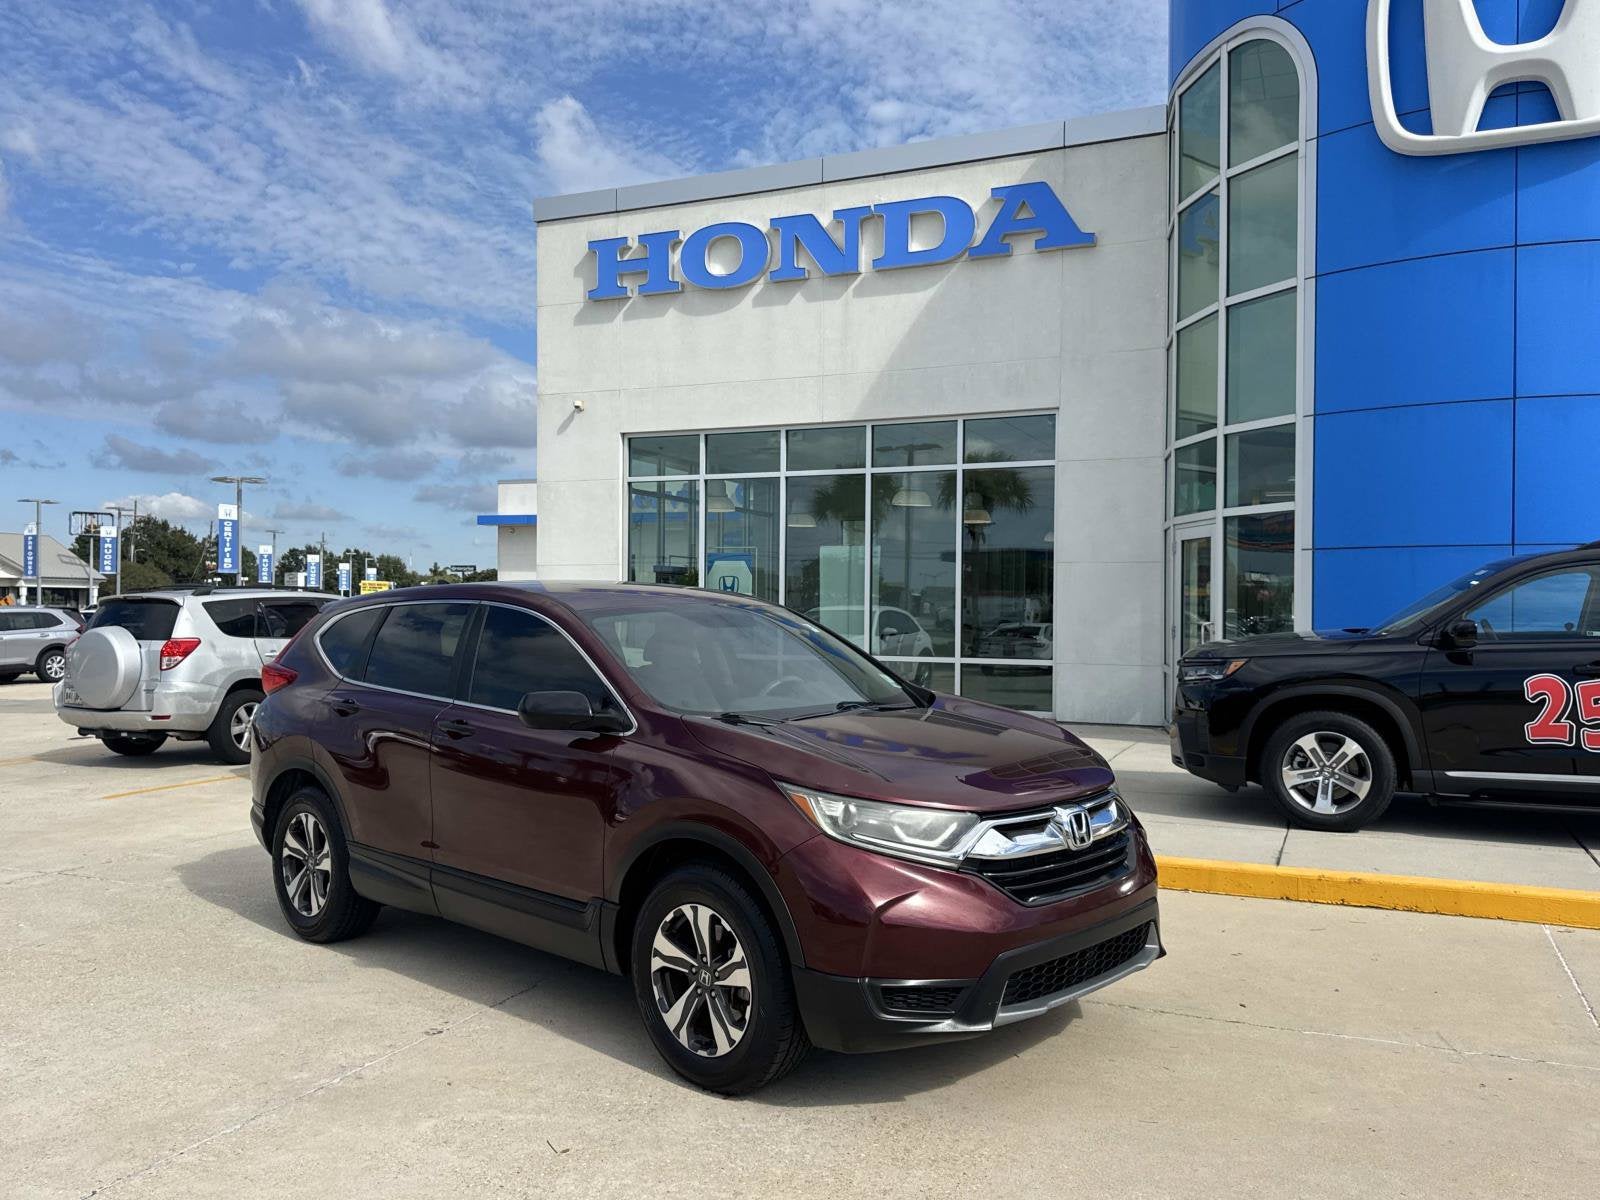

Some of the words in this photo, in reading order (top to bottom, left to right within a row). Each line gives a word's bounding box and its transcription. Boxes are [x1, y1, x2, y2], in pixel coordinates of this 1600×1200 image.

[587, 181, 1096, 301] HONDA
[104, 537, 112, 571] TRUCKS
[223, 521, 233, 569] CERTIFIED
